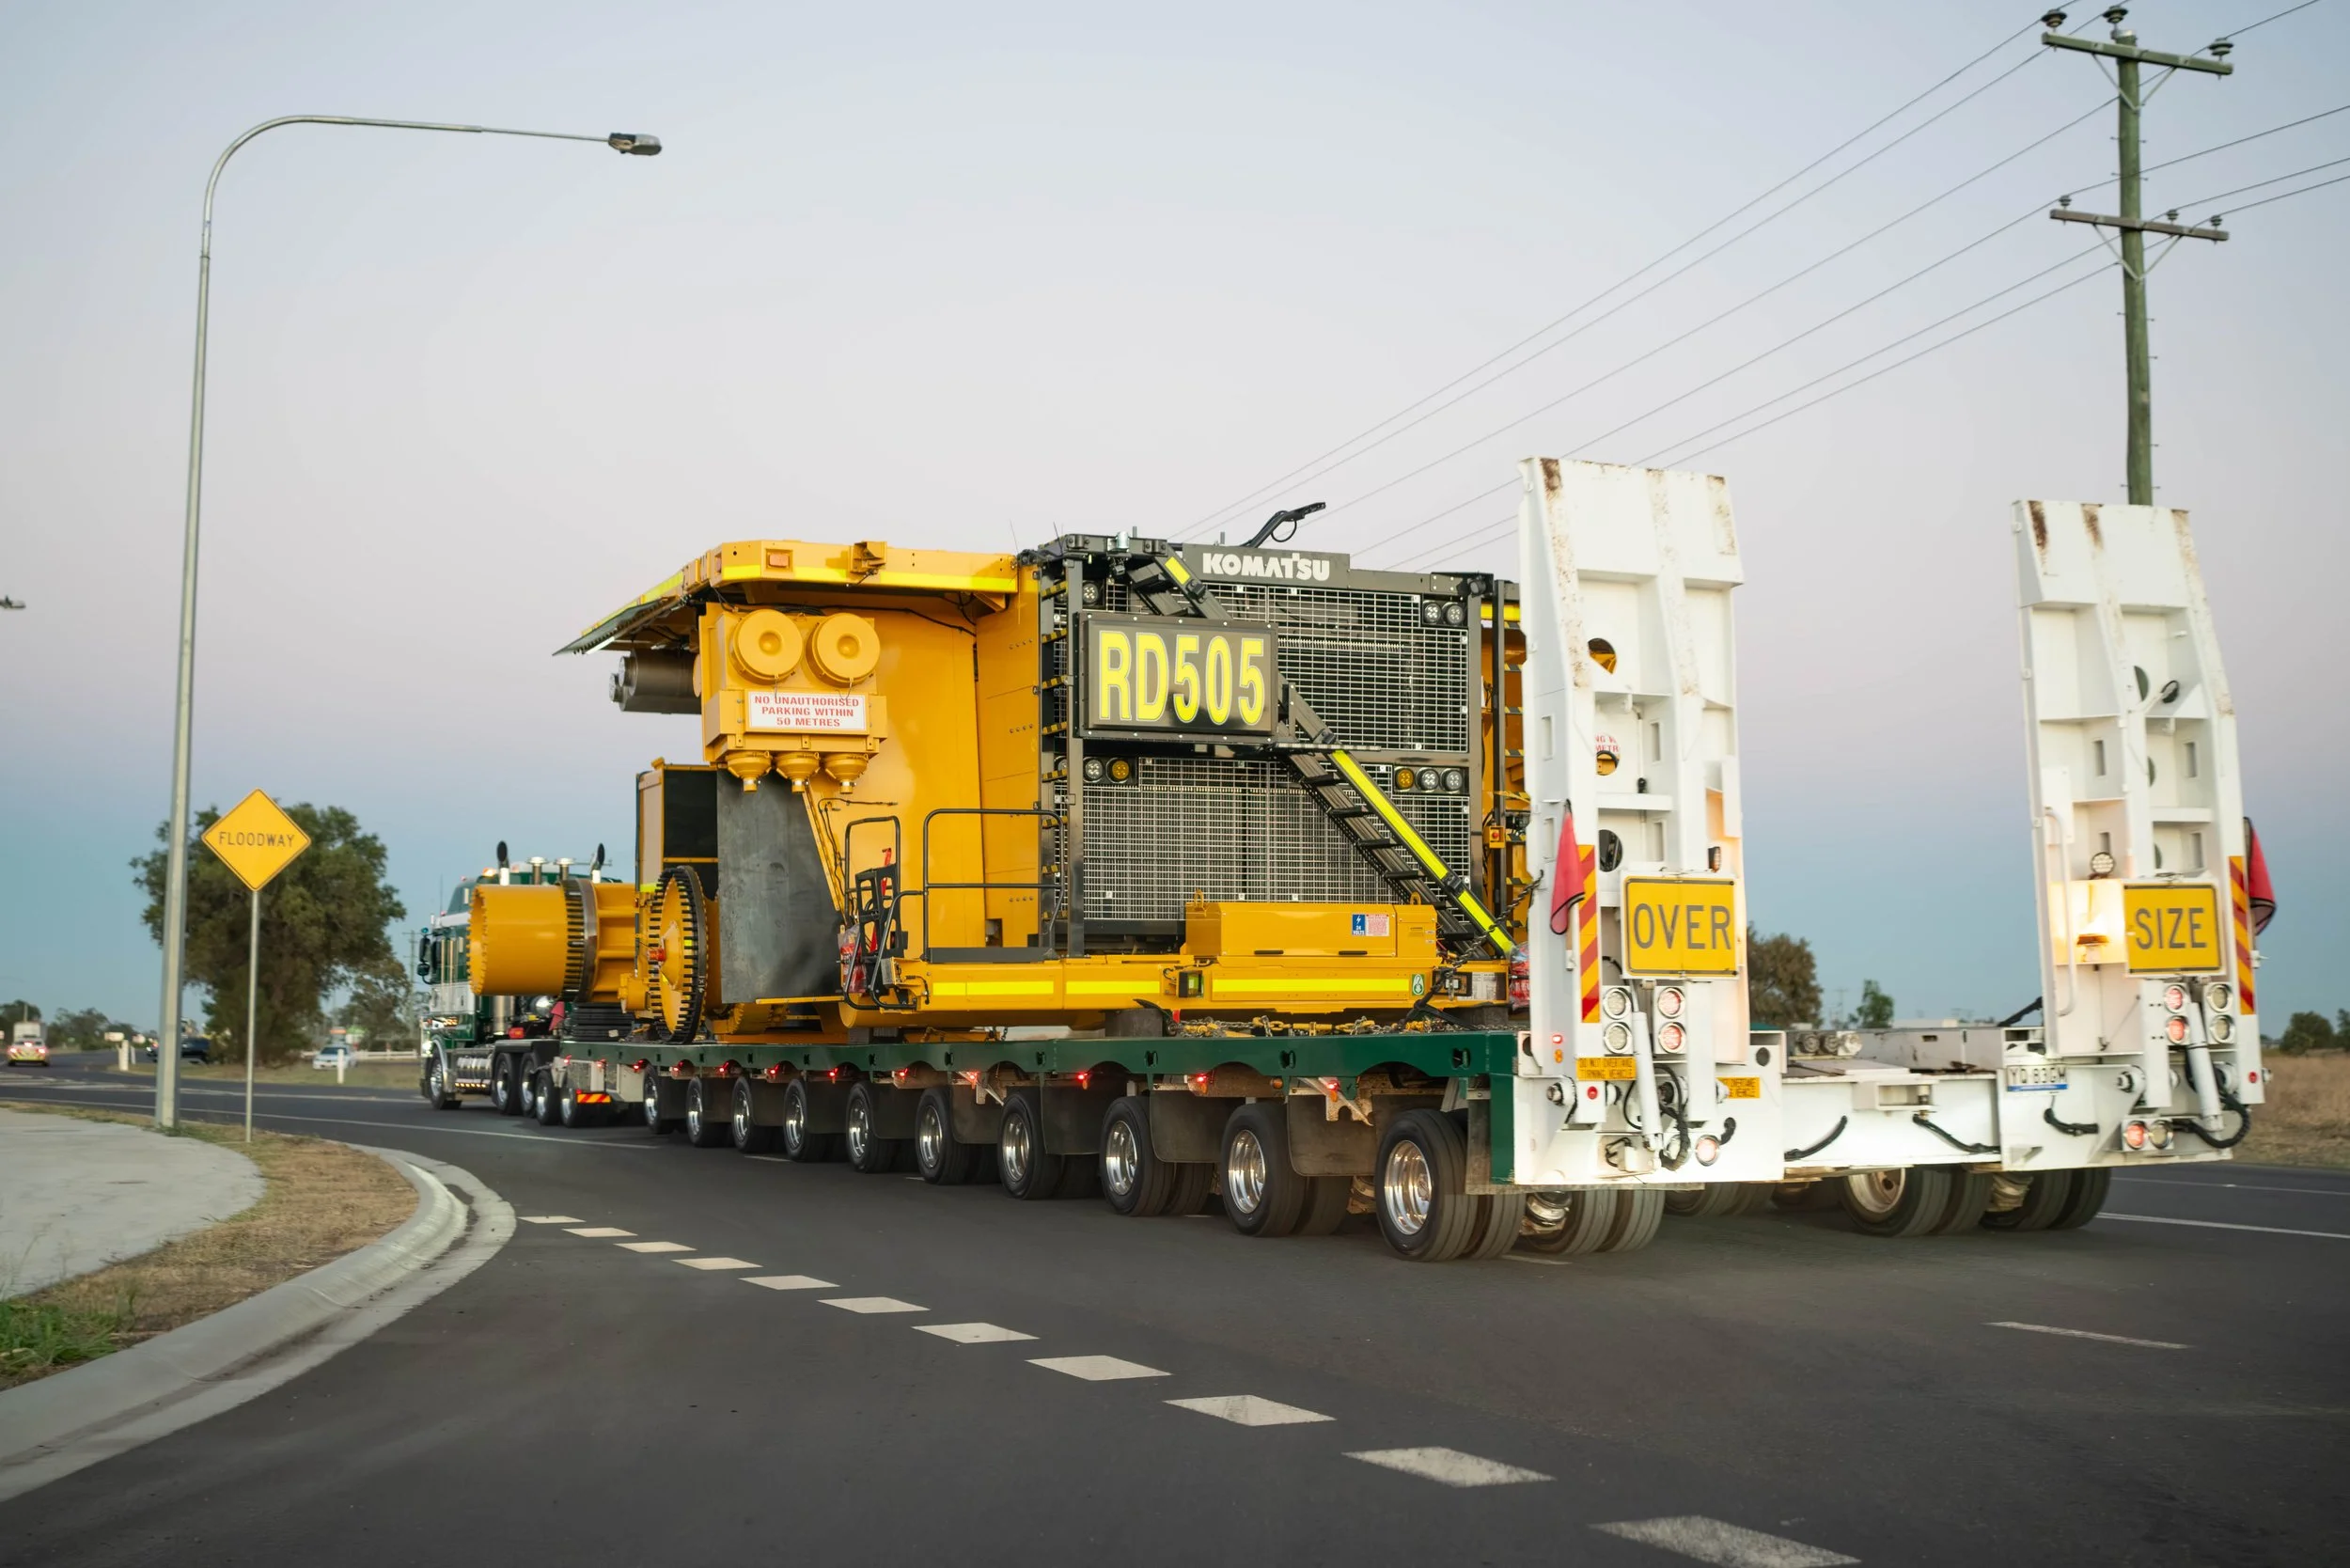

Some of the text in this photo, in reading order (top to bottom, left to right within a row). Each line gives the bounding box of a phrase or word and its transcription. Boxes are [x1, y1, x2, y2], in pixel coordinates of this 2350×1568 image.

[1203, 553, 1330, 581] KOMATSU
[1099, 631, 1265, 726] RD505
[754, 696, 859, 707] NO UNAUTHORISED
[761, 706, 854, 717] PARKING WITHIN
[776, 717, 840, 727] 50 METRES
[218, 831, 295, 847] FLOODWAY
[1634, 903, 1731, 949] OVER
[2135, 907, 2207, 949] SIZE
